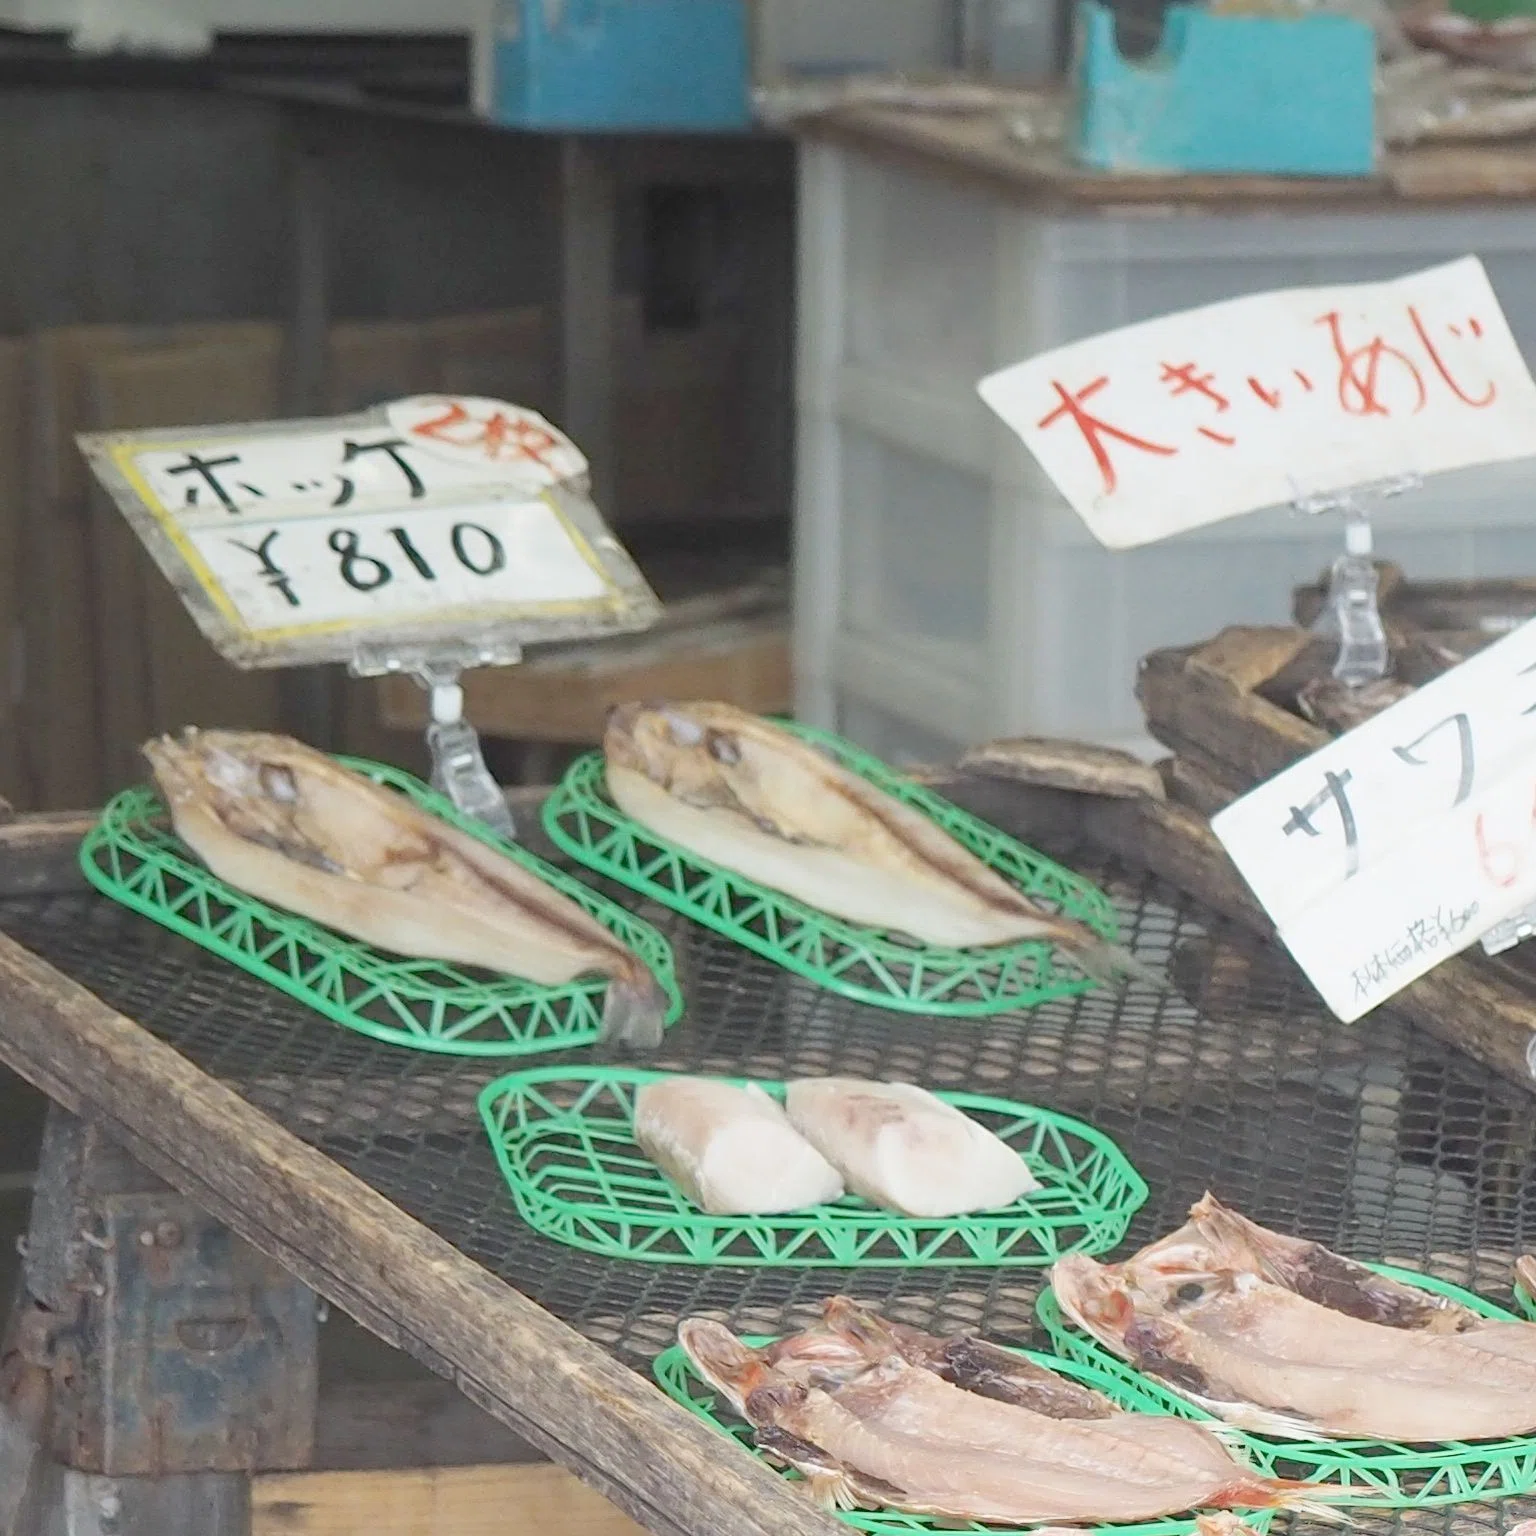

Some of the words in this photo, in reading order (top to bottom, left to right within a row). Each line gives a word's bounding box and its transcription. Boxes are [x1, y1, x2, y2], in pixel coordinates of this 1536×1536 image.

[1036, 304, 1497, 496] 大きいめじ
[166, 439, 426, 514] ホッケ
[227, 521, 506, 608] ¥810
